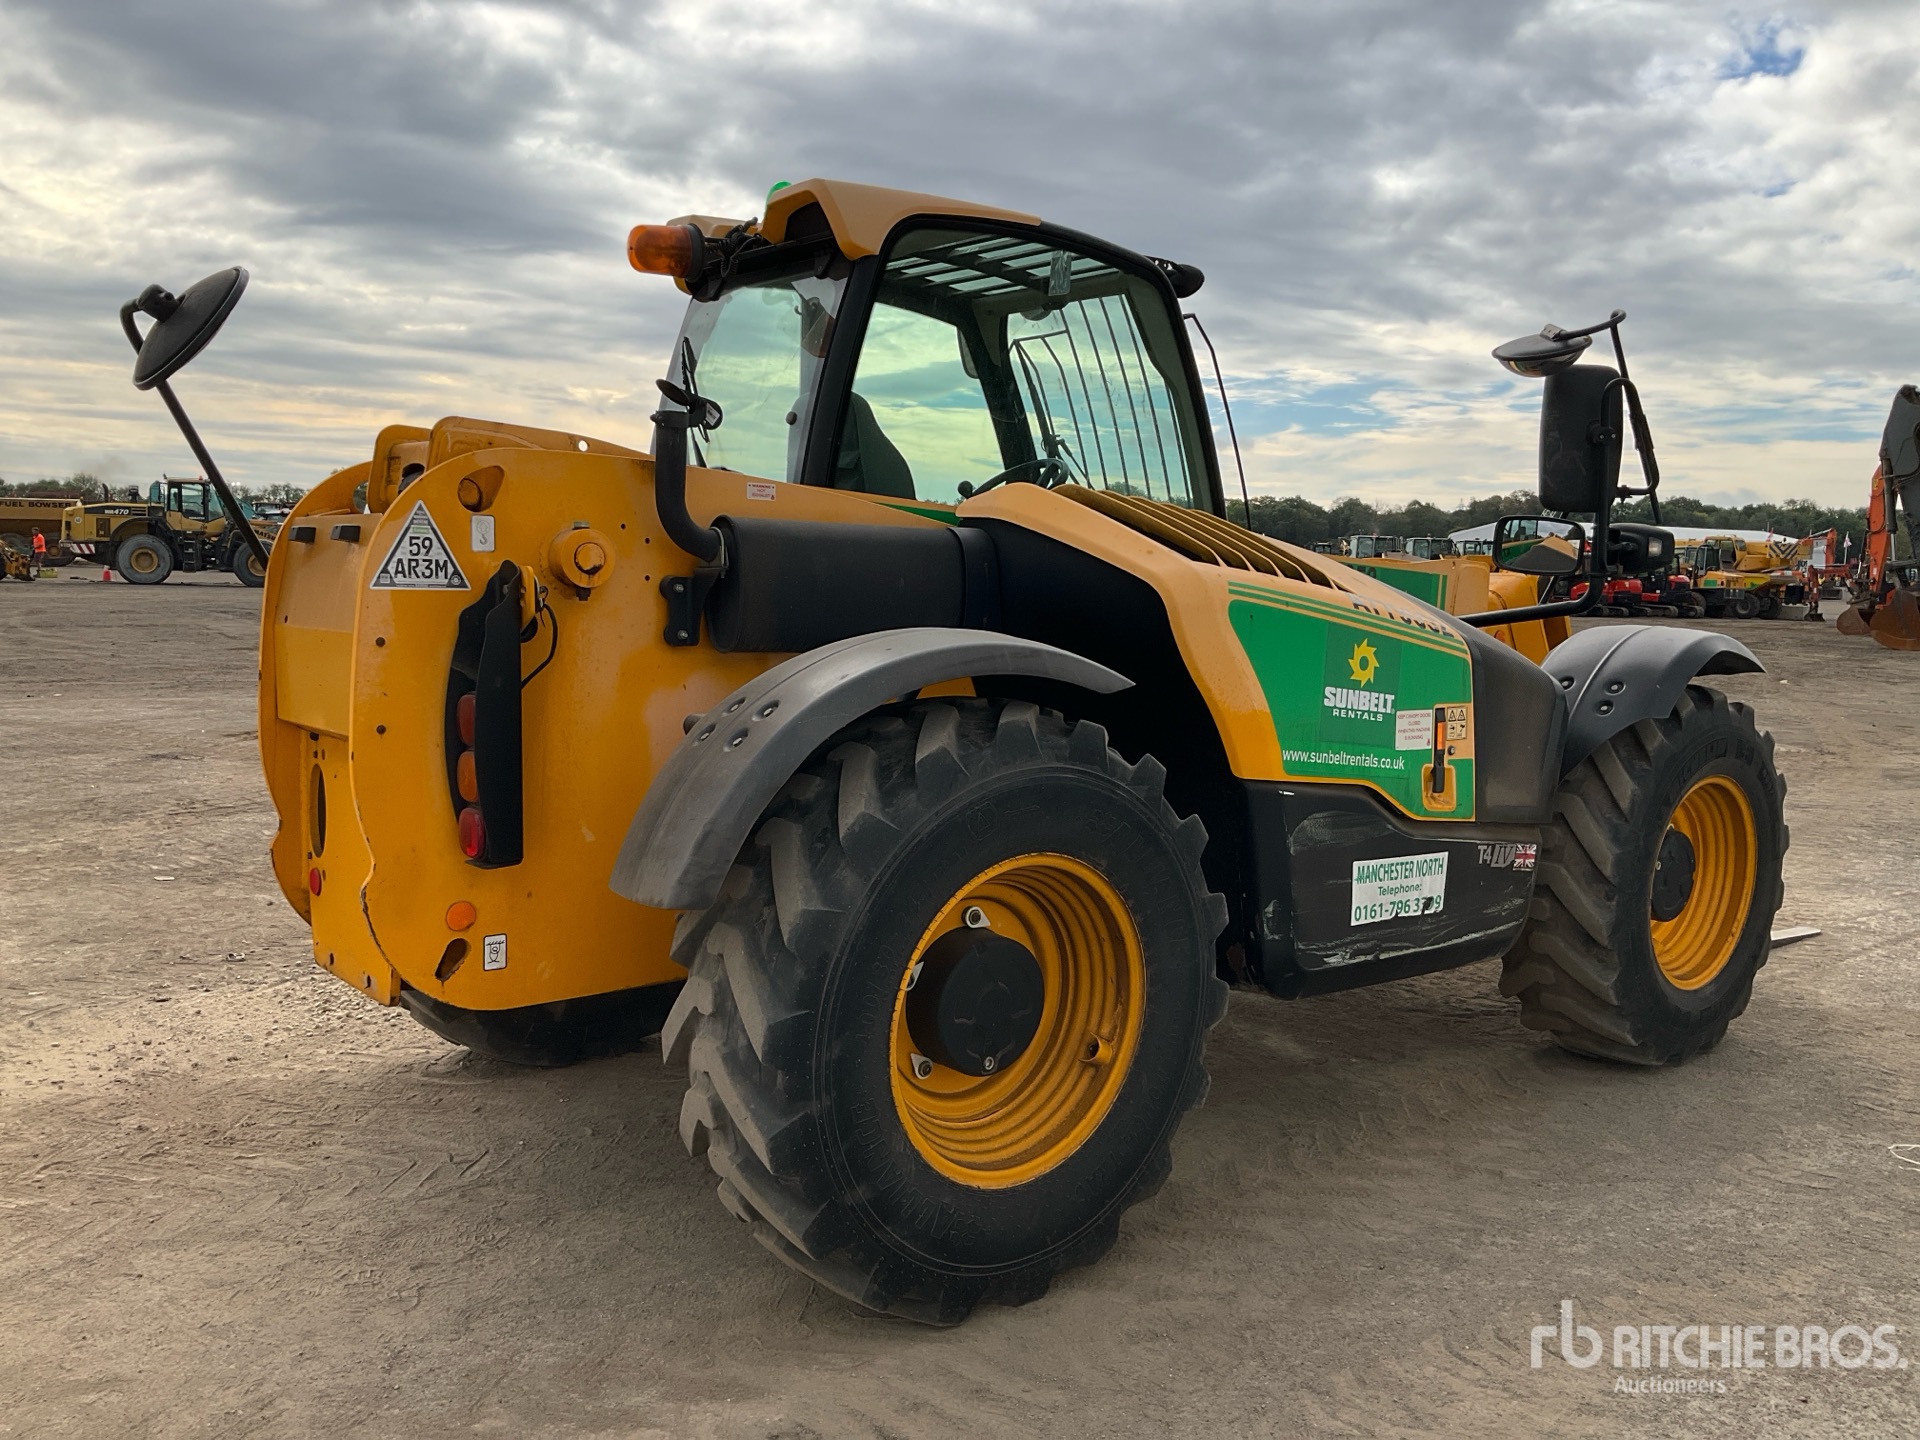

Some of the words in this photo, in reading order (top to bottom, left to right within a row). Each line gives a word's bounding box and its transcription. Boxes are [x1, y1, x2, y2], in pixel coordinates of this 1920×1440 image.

[409, 536, 433, 556] 59
[394, 558, 448, 579] AR3M
[1323, 686, 1395, 714] SUNBELT
[1332, 708, 1383, 722] RENTALS
[1282, 750, 1405, 770] www.sunbeltrentals.co.uk
[1355, 862, 1414, 884] MANCHESTER
[1415, 857, 1444, 877] NORTH
[1378, 883, 1422, 896] Telephone:
[1354, 899, 1411, 921] 0161-796
